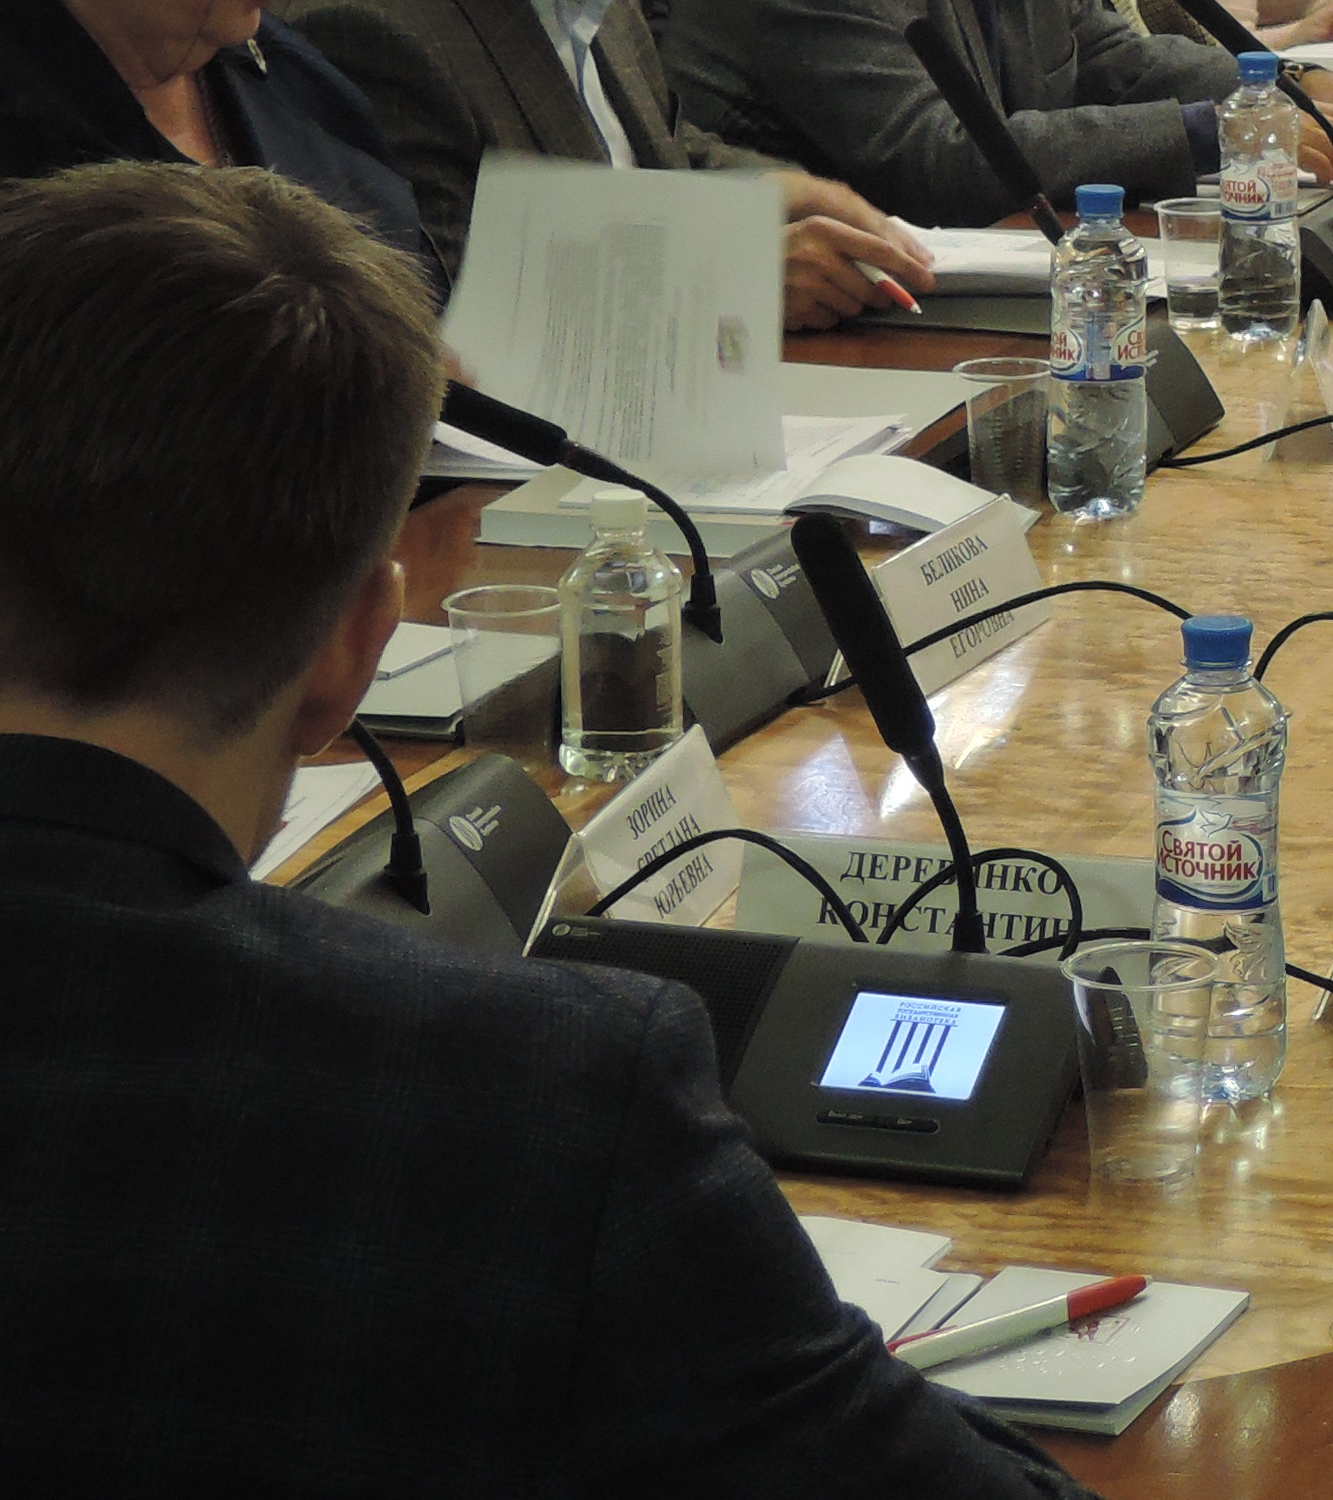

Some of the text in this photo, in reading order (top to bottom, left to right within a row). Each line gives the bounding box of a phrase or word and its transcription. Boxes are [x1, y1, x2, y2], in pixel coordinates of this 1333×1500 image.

[920, 534, 989, 586] БЕЛИКОВА
[950, 578, 990, 612] НИНА
[626, 783, 677, 841] ЗОРИНА
[654, 852, 714, 920] ЮРЬЕВНА
[839, 851, 1062, 896] ДЕРЕВНКО
[816, 897, 1073, 942] КОНСТНТИН
